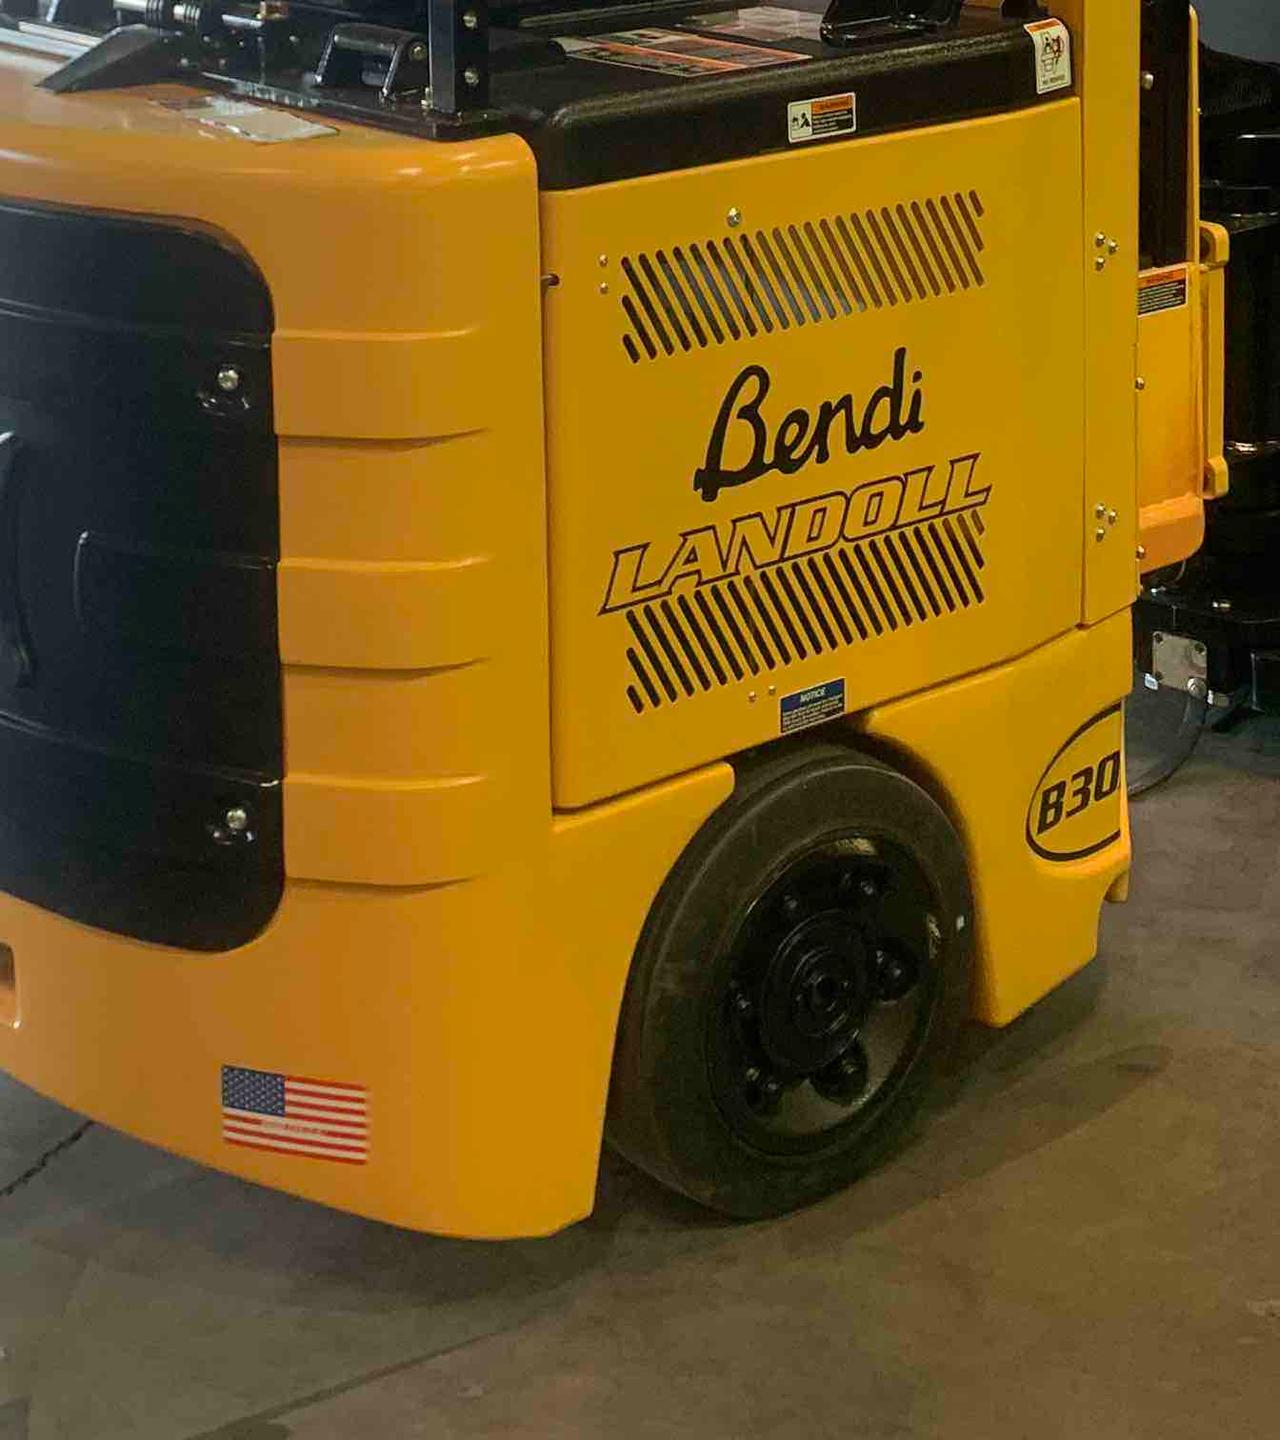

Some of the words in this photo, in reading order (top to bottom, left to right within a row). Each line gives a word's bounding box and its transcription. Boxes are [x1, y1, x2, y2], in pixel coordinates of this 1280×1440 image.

[693, 346, 926, 503] Bendi
[598, 452, 993, 616] LANDOLL
[1037, 750, 1121, 836] B30
